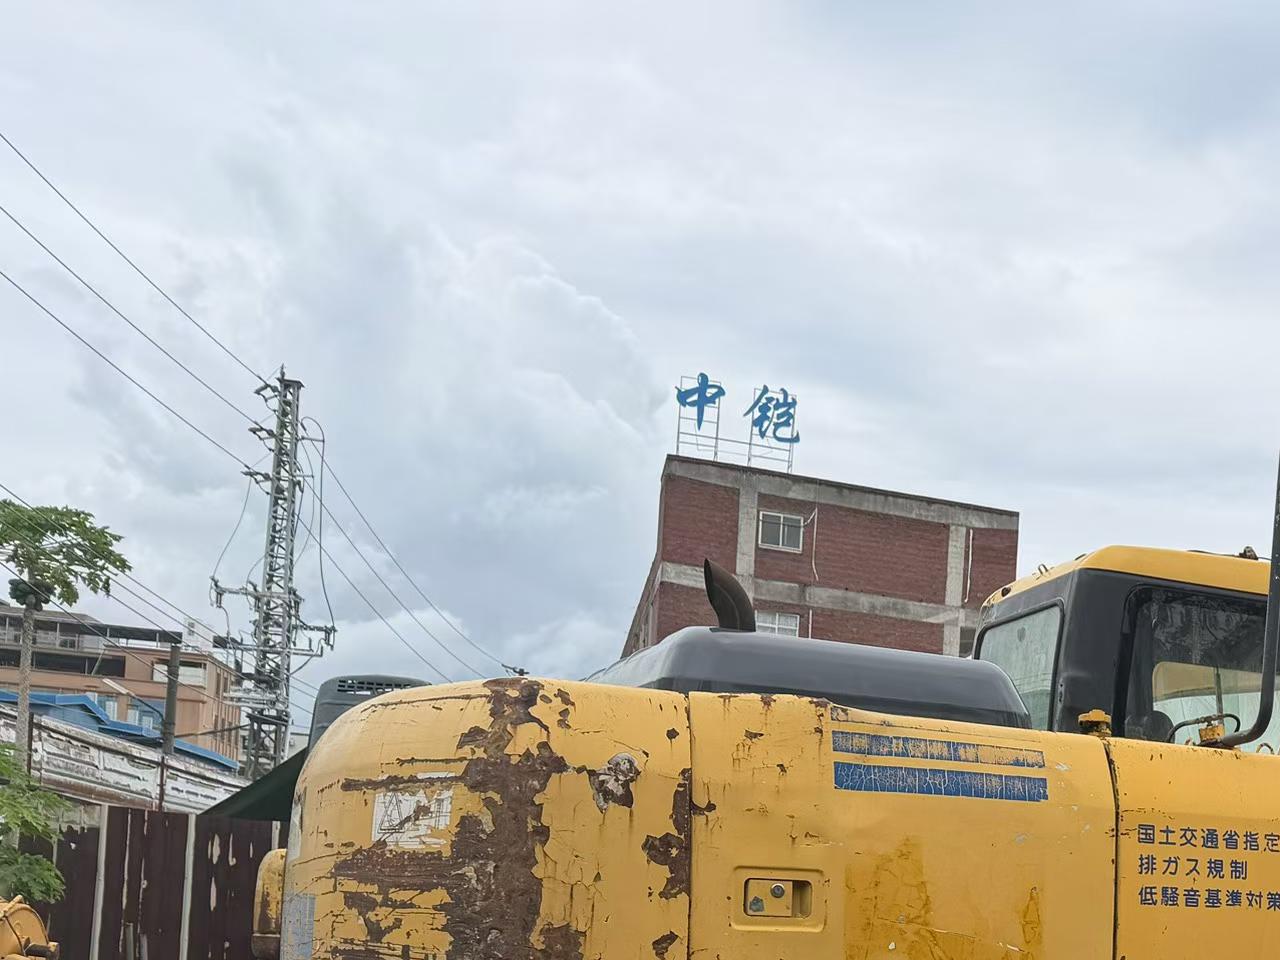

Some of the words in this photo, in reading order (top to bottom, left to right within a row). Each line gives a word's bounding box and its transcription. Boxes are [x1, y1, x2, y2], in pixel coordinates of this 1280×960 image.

[1137, 824, 1280, 853] 国土交通省指定
[1138, 854, 1248, 880] 排ガス規制
